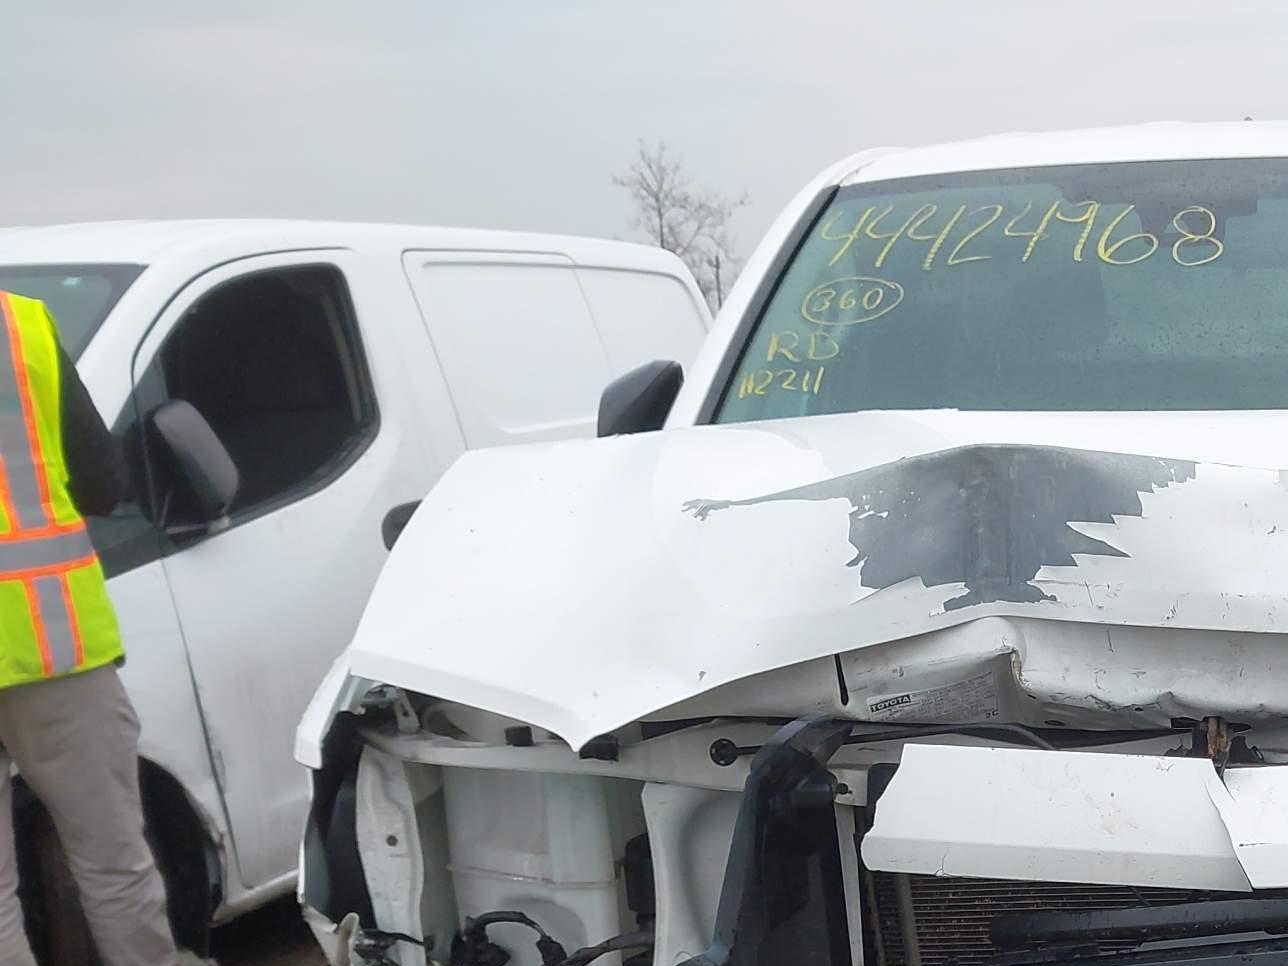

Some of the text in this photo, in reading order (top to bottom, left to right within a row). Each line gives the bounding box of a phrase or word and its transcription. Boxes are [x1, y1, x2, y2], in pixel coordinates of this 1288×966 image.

[819, 200, 1224, 269] 44424968
[811, 287, 884, 313] 360
[872, 696, 910, 711] TOYOTA
